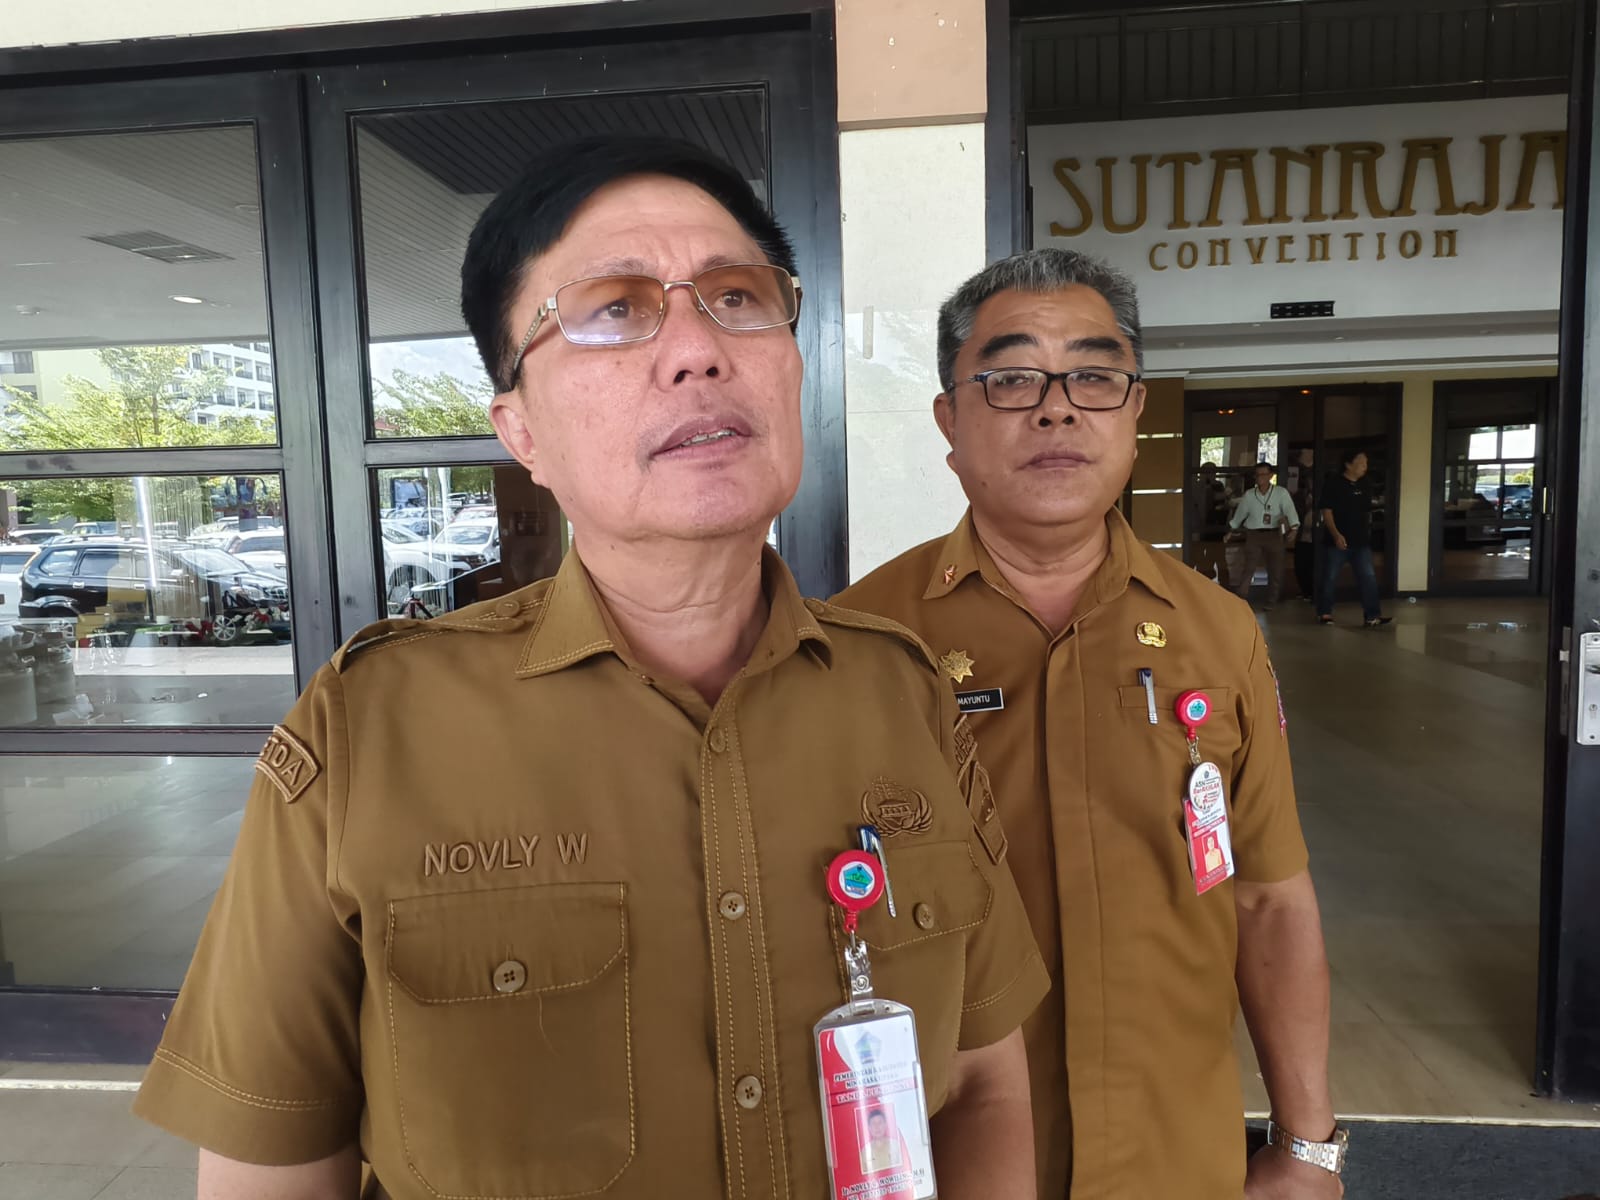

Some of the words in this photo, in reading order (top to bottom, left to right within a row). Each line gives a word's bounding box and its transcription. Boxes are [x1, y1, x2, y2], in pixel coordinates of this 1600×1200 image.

[1049, 130, 1567, 237] SUTANRAJA
[1148, 229, 1459, 271] CONVENTION
[957, 695, 990, 705] MAYUNTU
[424, 835, 539, 877] NOVLY
[557, 832, 588, 864] W
